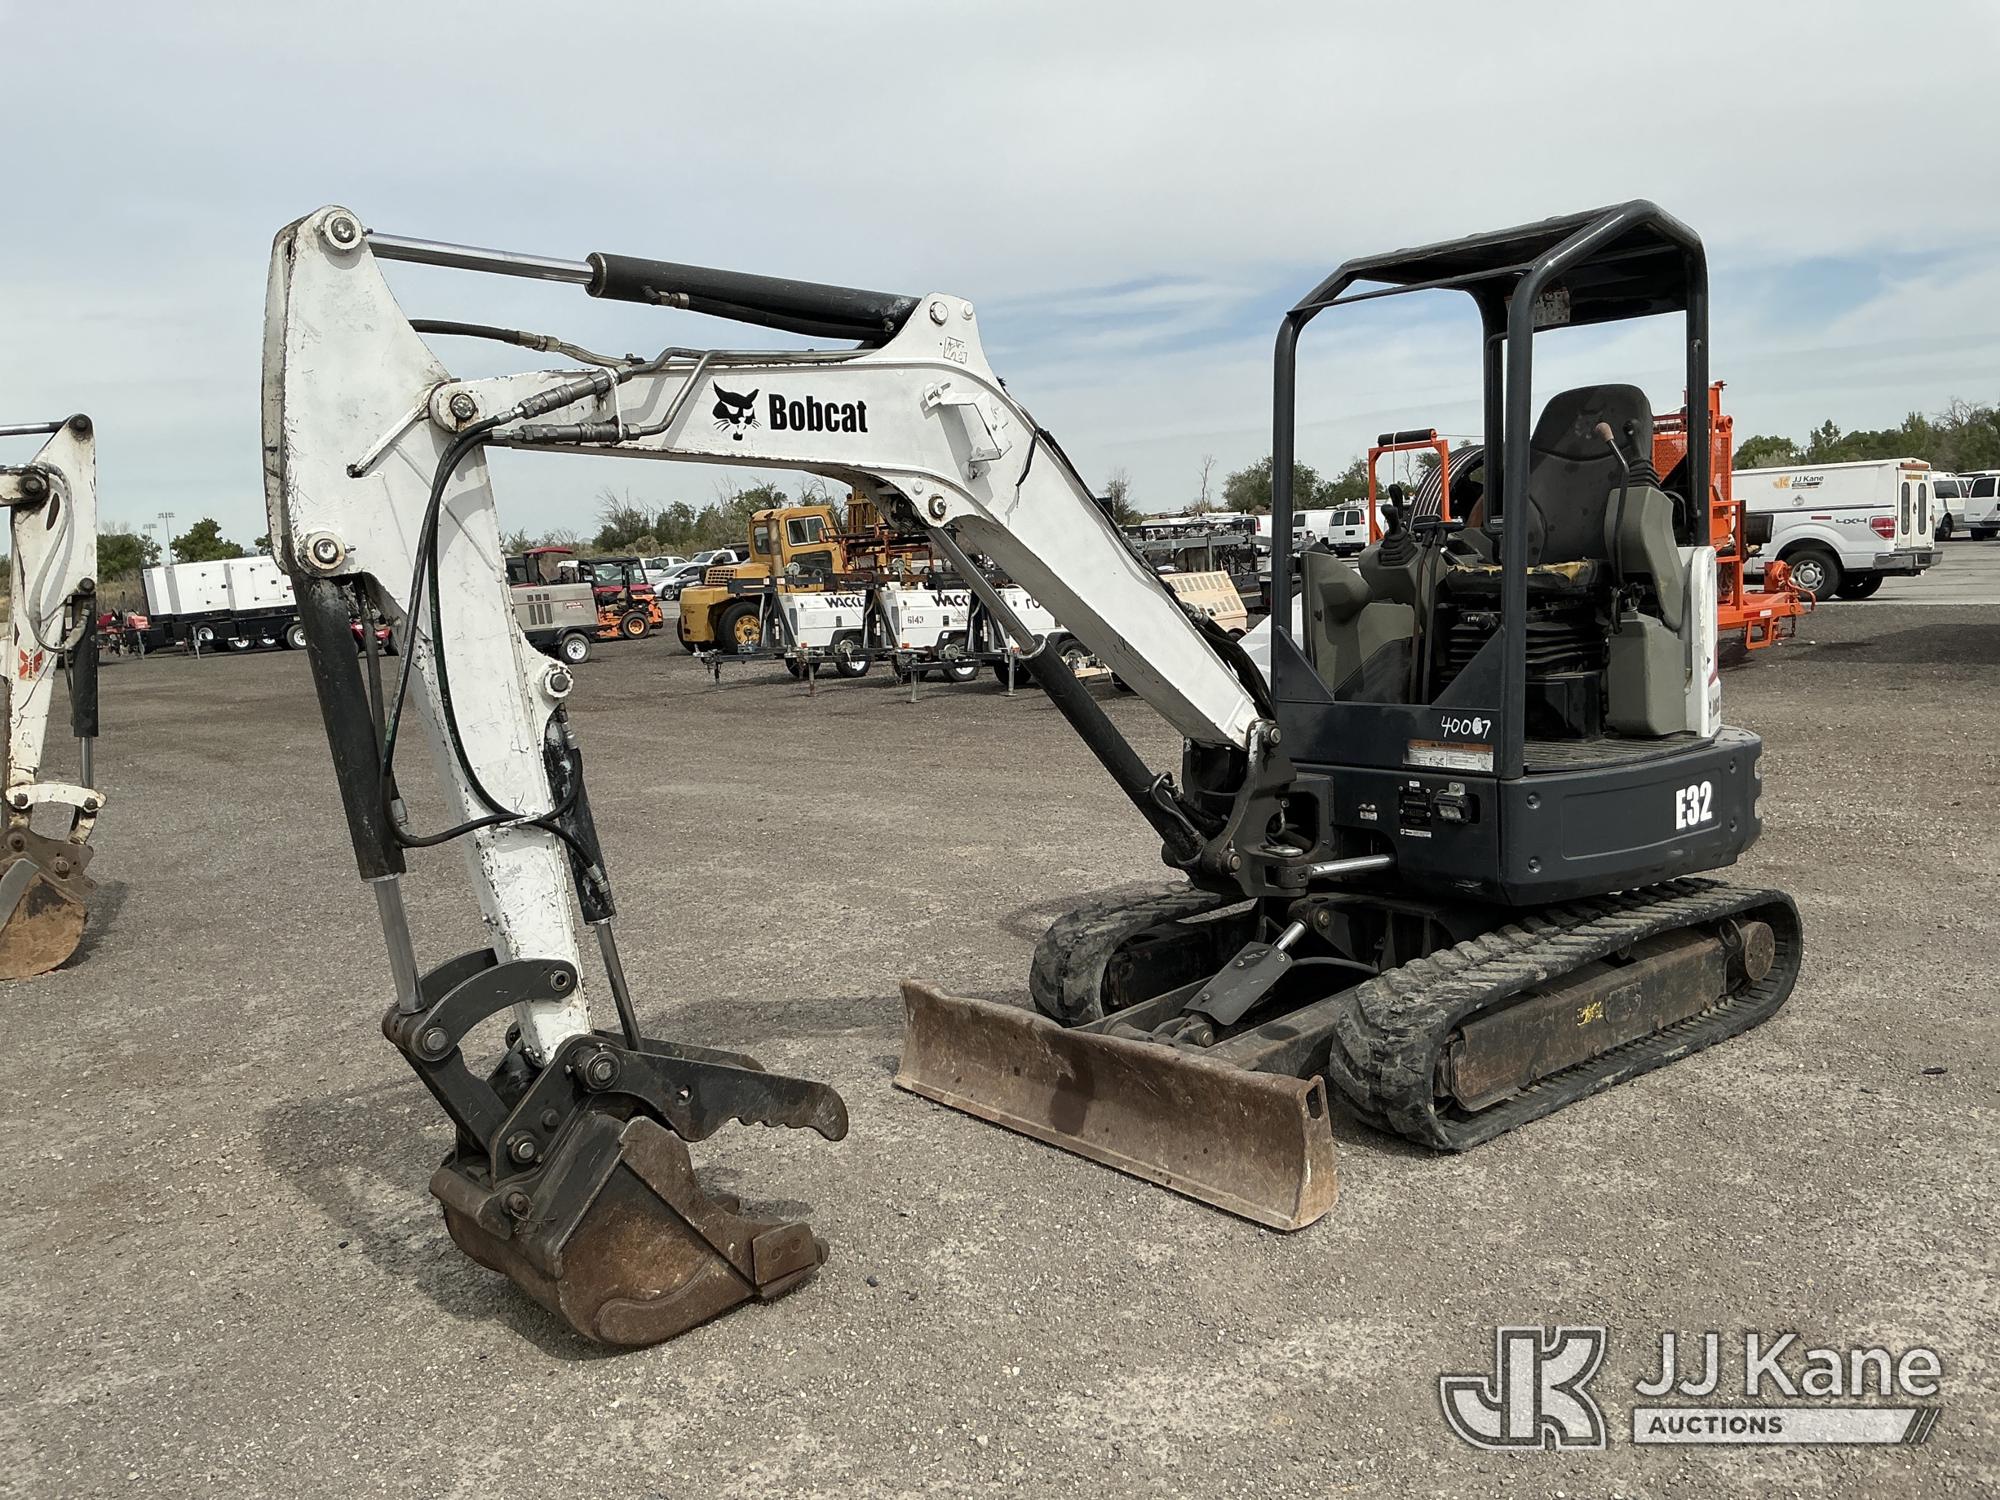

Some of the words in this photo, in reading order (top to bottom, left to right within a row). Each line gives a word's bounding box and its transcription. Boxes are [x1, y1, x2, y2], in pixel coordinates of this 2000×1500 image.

[769, 394, 868, 433] Bobcat
[1803, 474, 1824, 482] Kane
[931, 595, 969, 607] WACK
[1675, 780, 1713, 830] E32
